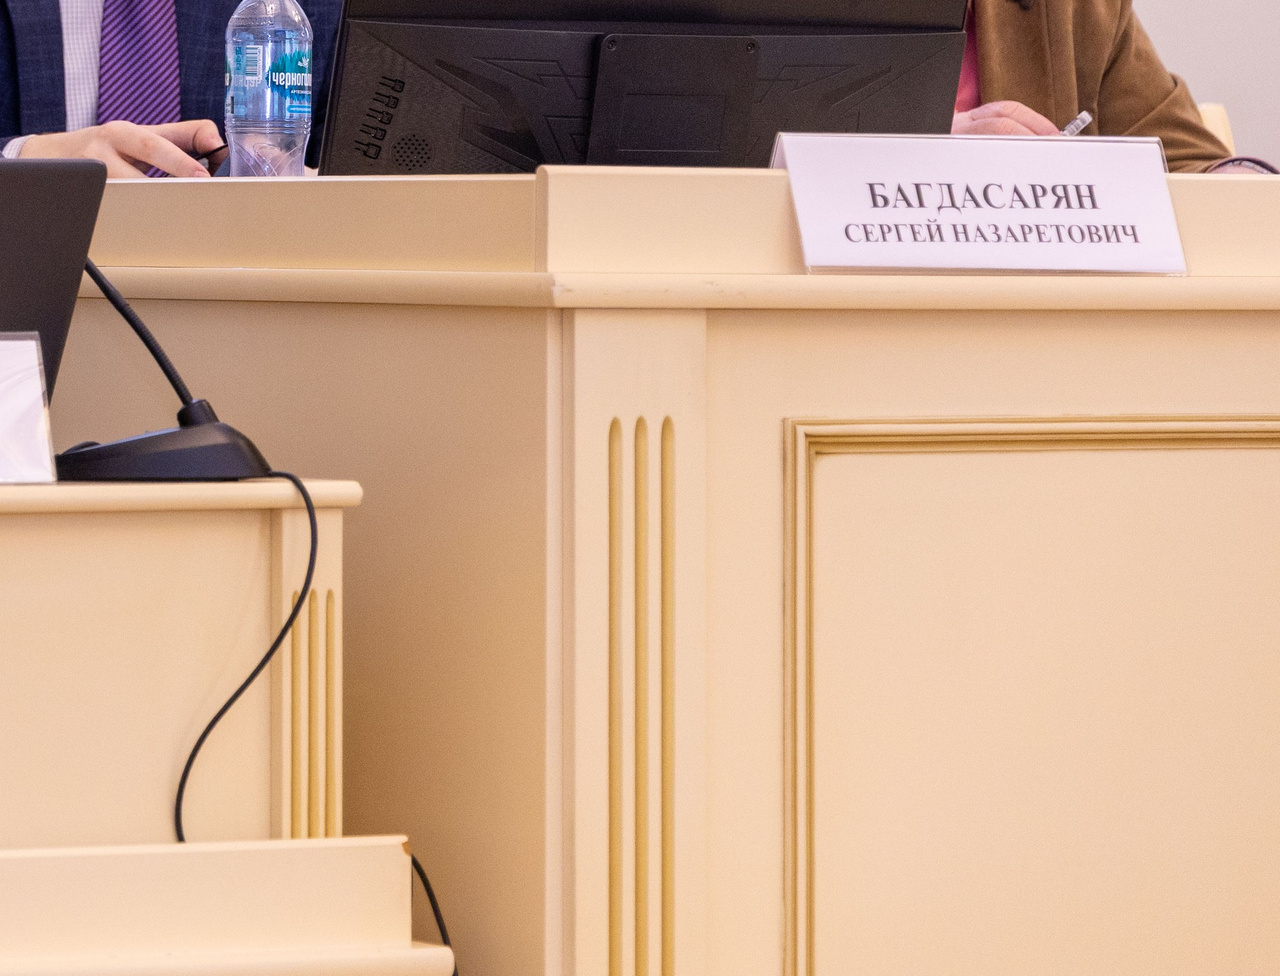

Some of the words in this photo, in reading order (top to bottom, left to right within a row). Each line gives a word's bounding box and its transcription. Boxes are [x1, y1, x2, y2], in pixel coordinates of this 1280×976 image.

[866, 182, 1100, 214] БАГДАСАРЯН
[844, 219, 948, 243] СЕРГЕЙ
[951, 224, 1141, 244] НАЗАРЕТОВИЧ
